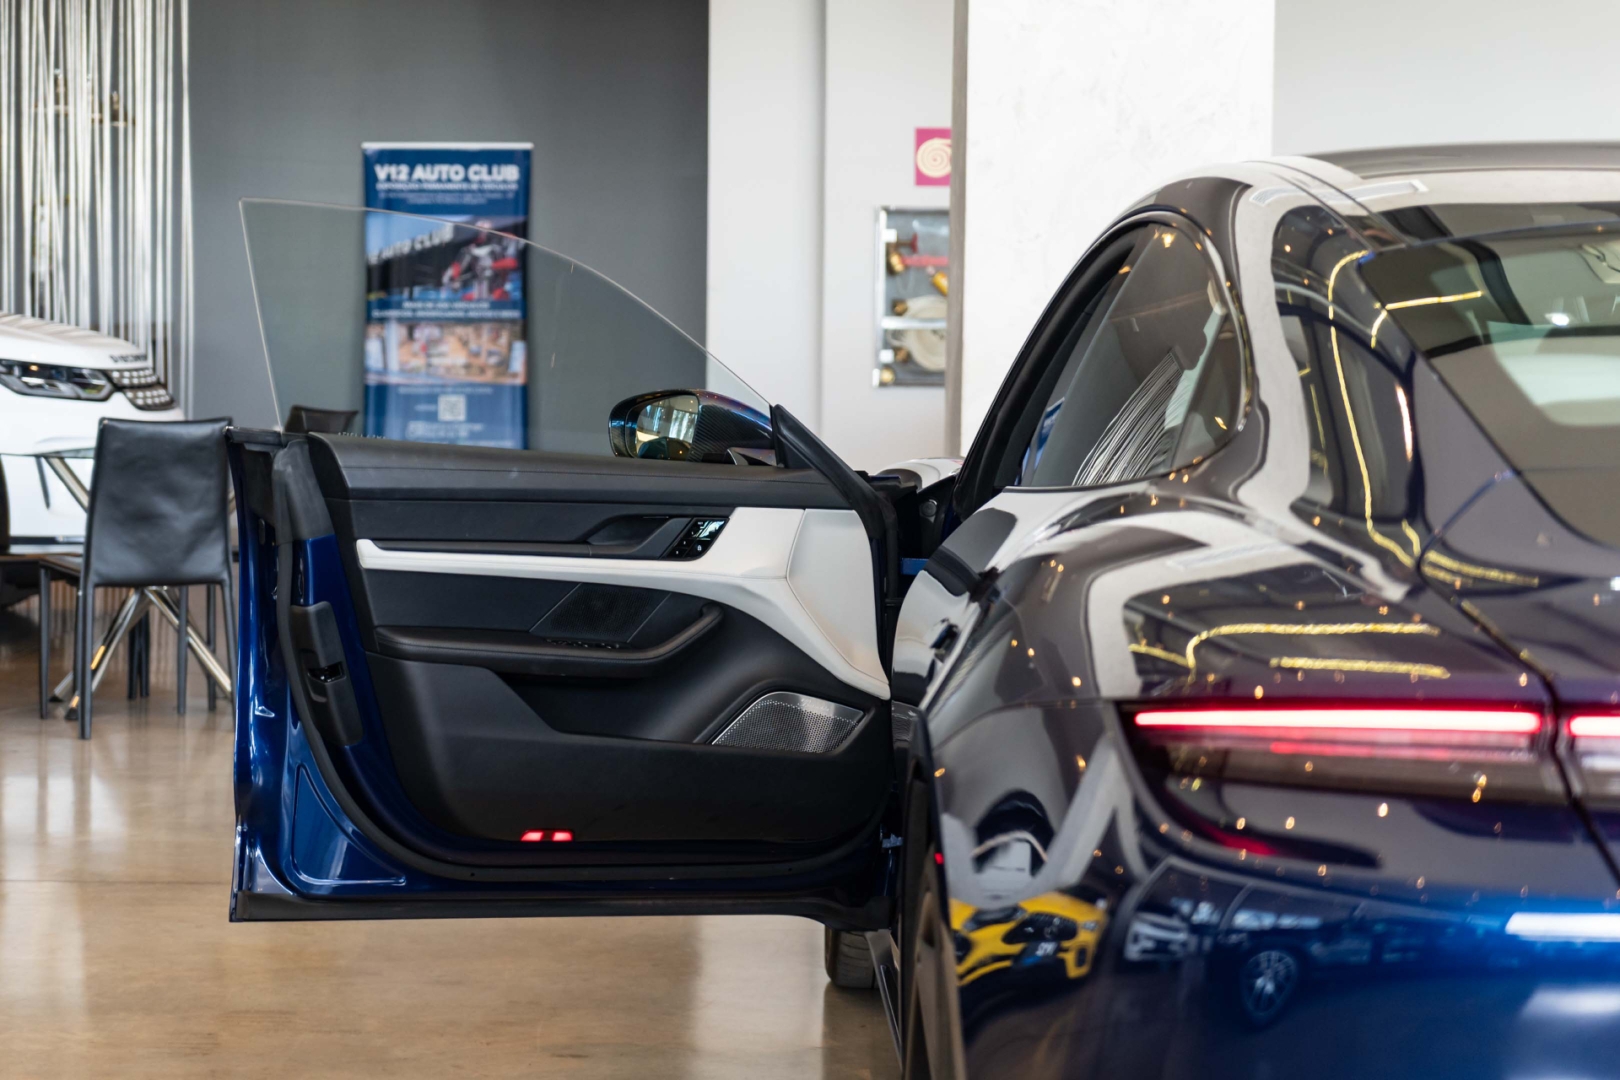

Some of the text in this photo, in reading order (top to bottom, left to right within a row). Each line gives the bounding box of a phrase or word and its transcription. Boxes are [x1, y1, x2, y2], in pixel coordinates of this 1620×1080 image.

[374, 164, 520, 182] V12 AUTO CLUB
